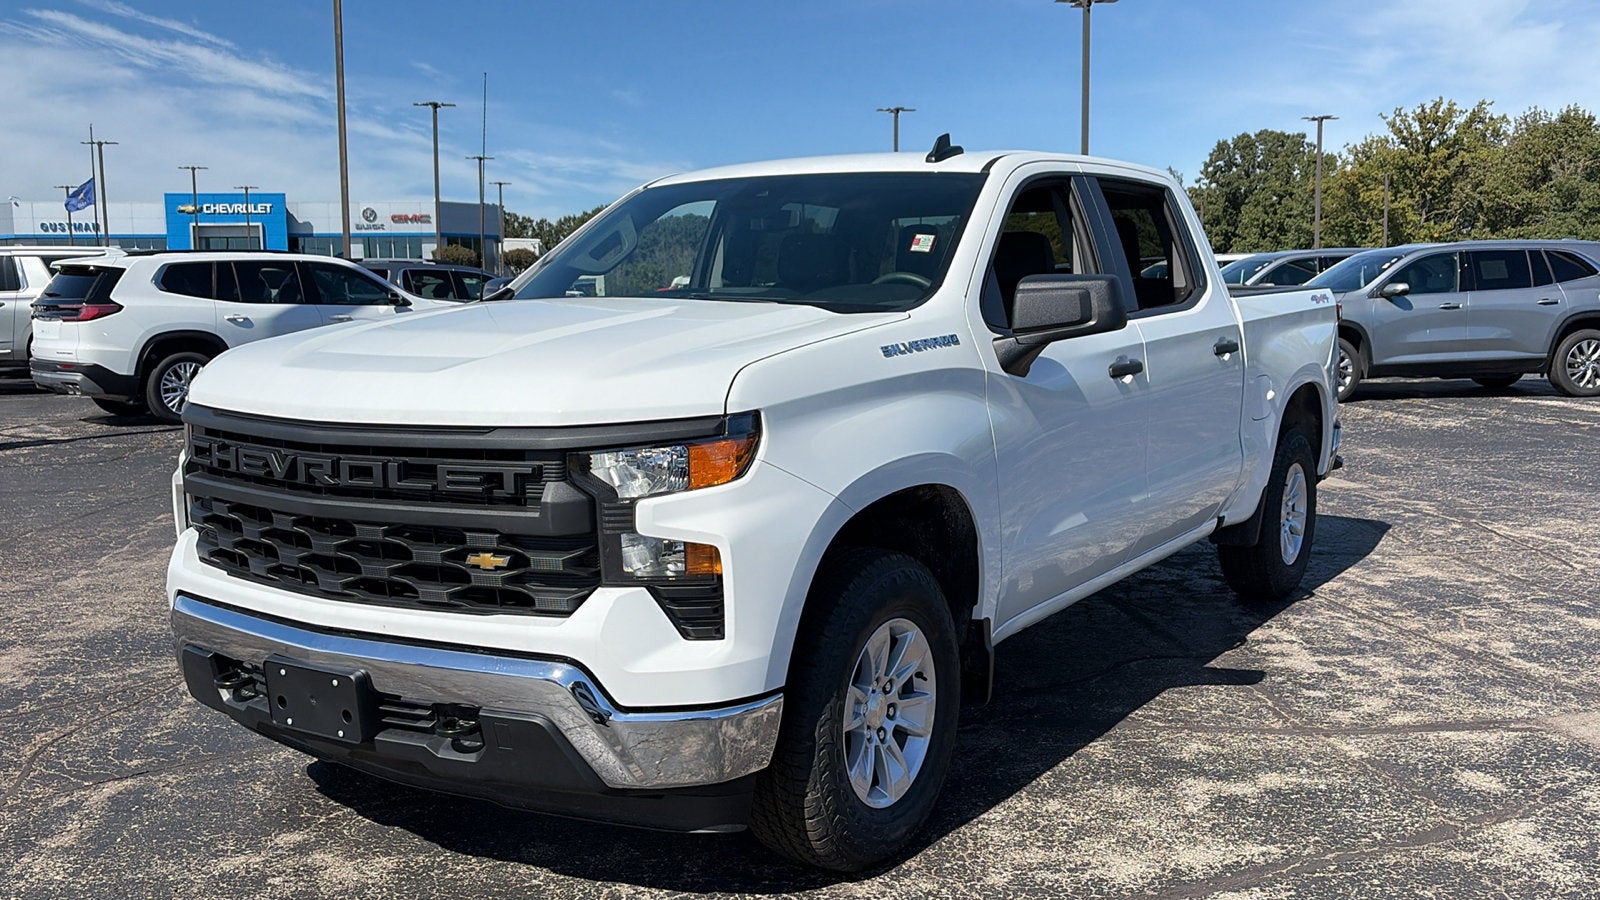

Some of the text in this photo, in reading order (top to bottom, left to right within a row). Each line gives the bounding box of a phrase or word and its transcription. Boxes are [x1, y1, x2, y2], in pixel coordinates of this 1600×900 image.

[202, 203, 273, 214] CHEVROLET
[391, 214, 432, 224] GMC
[355, 223, 385, 231] BUICK
[880, 334, 961, 358] SILVERADO
[190, 439, 532, 494] CHEVROLET
